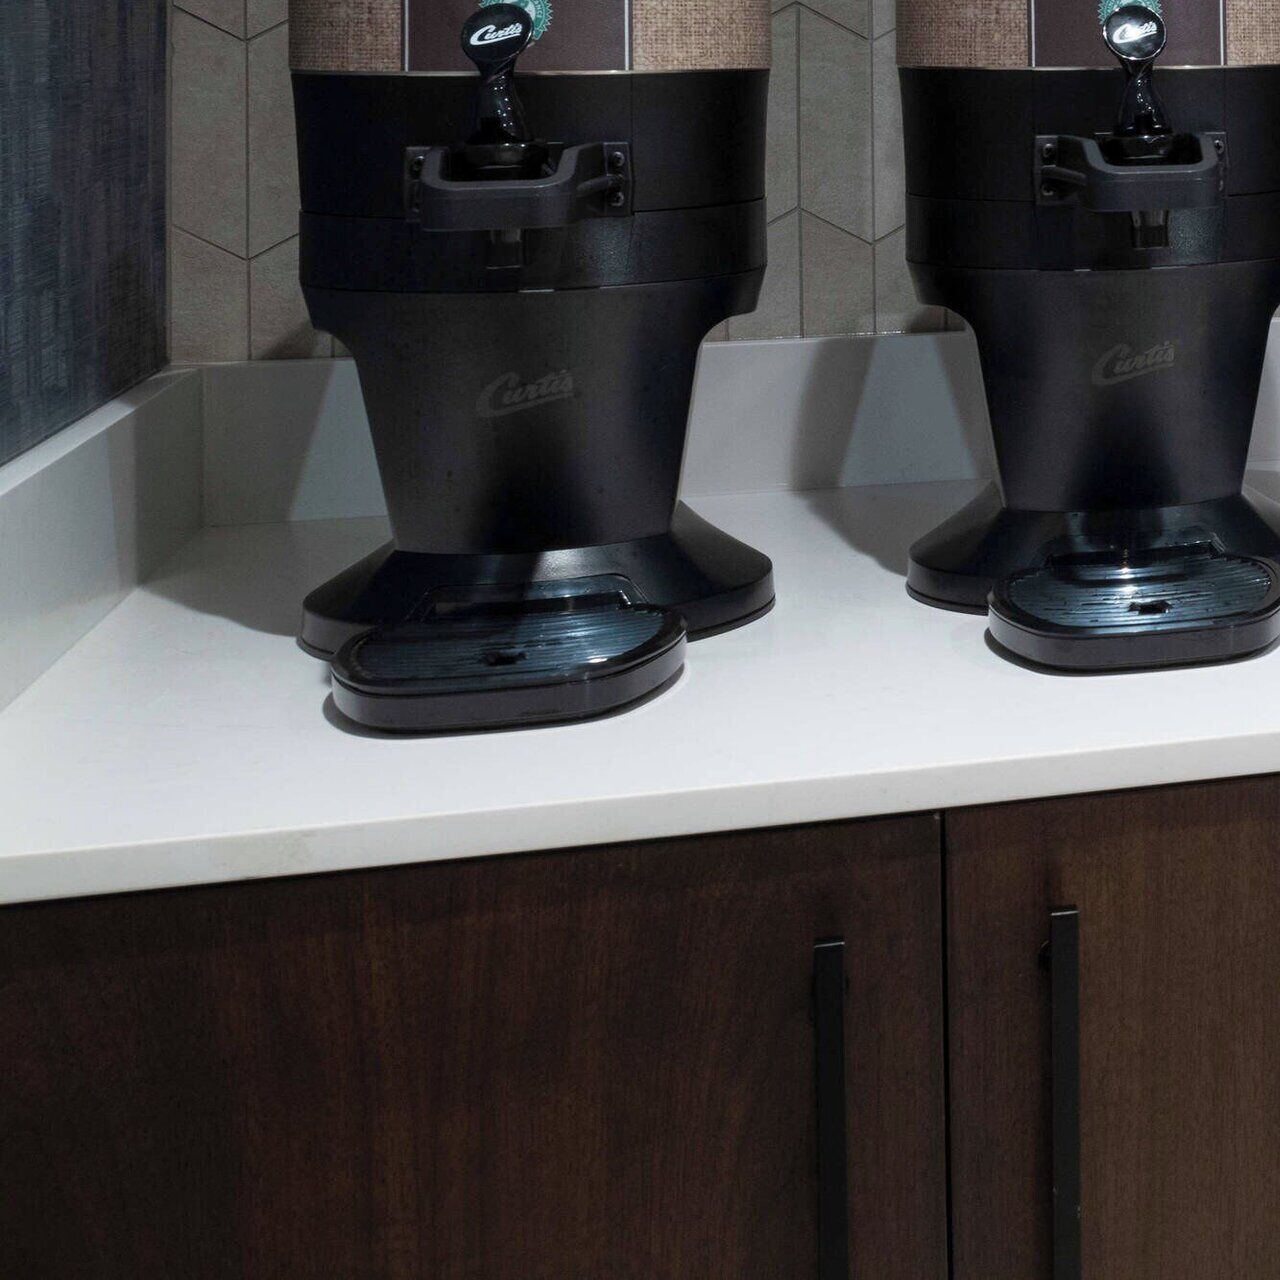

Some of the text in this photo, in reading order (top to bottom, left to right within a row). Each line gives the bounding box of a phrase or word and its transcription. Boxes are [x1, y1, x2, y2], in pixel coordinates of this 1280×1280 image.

[470, 22, 522, 45] Curtis
[1112, 21, 1157, 44] Ctis
[1090, 340, 1175, 386] Curtis
[475, 368, 575, 417] Curtis
